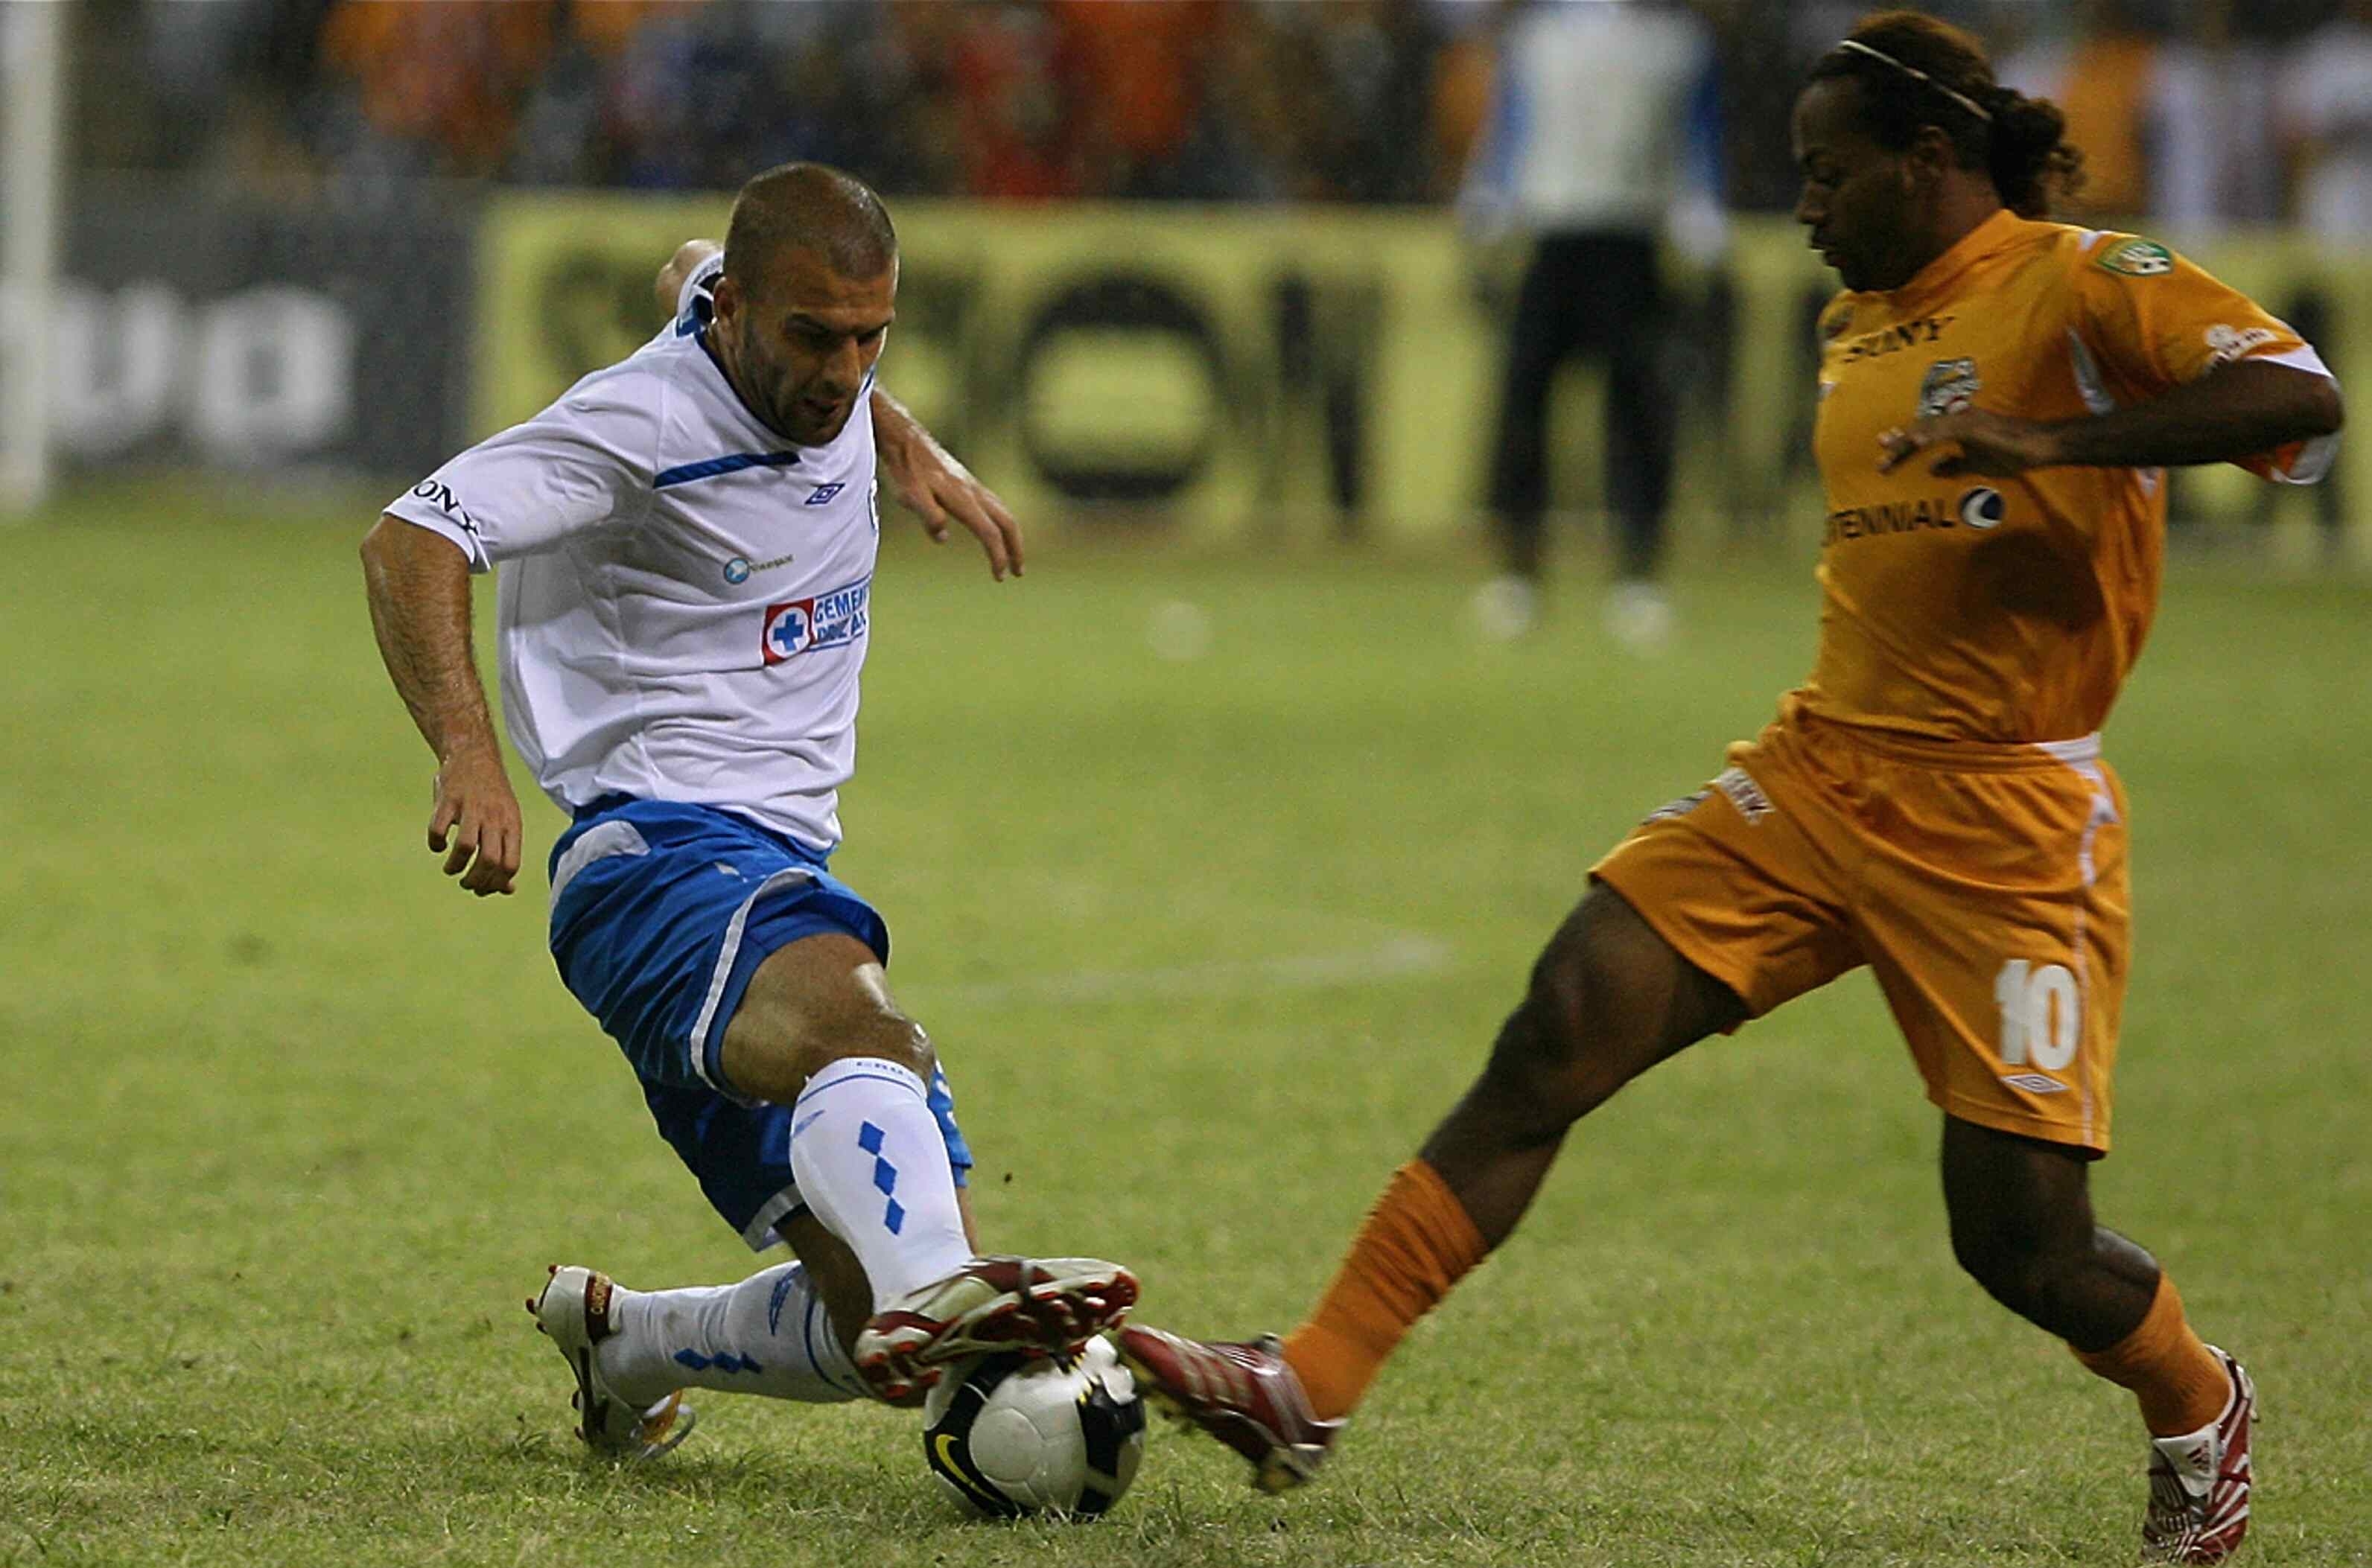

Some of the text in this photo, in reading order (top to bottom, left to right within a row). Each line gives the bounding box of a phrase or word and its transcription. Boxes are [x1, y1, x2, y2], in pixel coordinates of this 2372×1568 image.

[1842, 316, 1956, 363] SONY
[413, 479, 479, 536] ONY
[1821, 499, 1955, 547] TENNIAL
[1994, 958, 2078, 1070] 10
